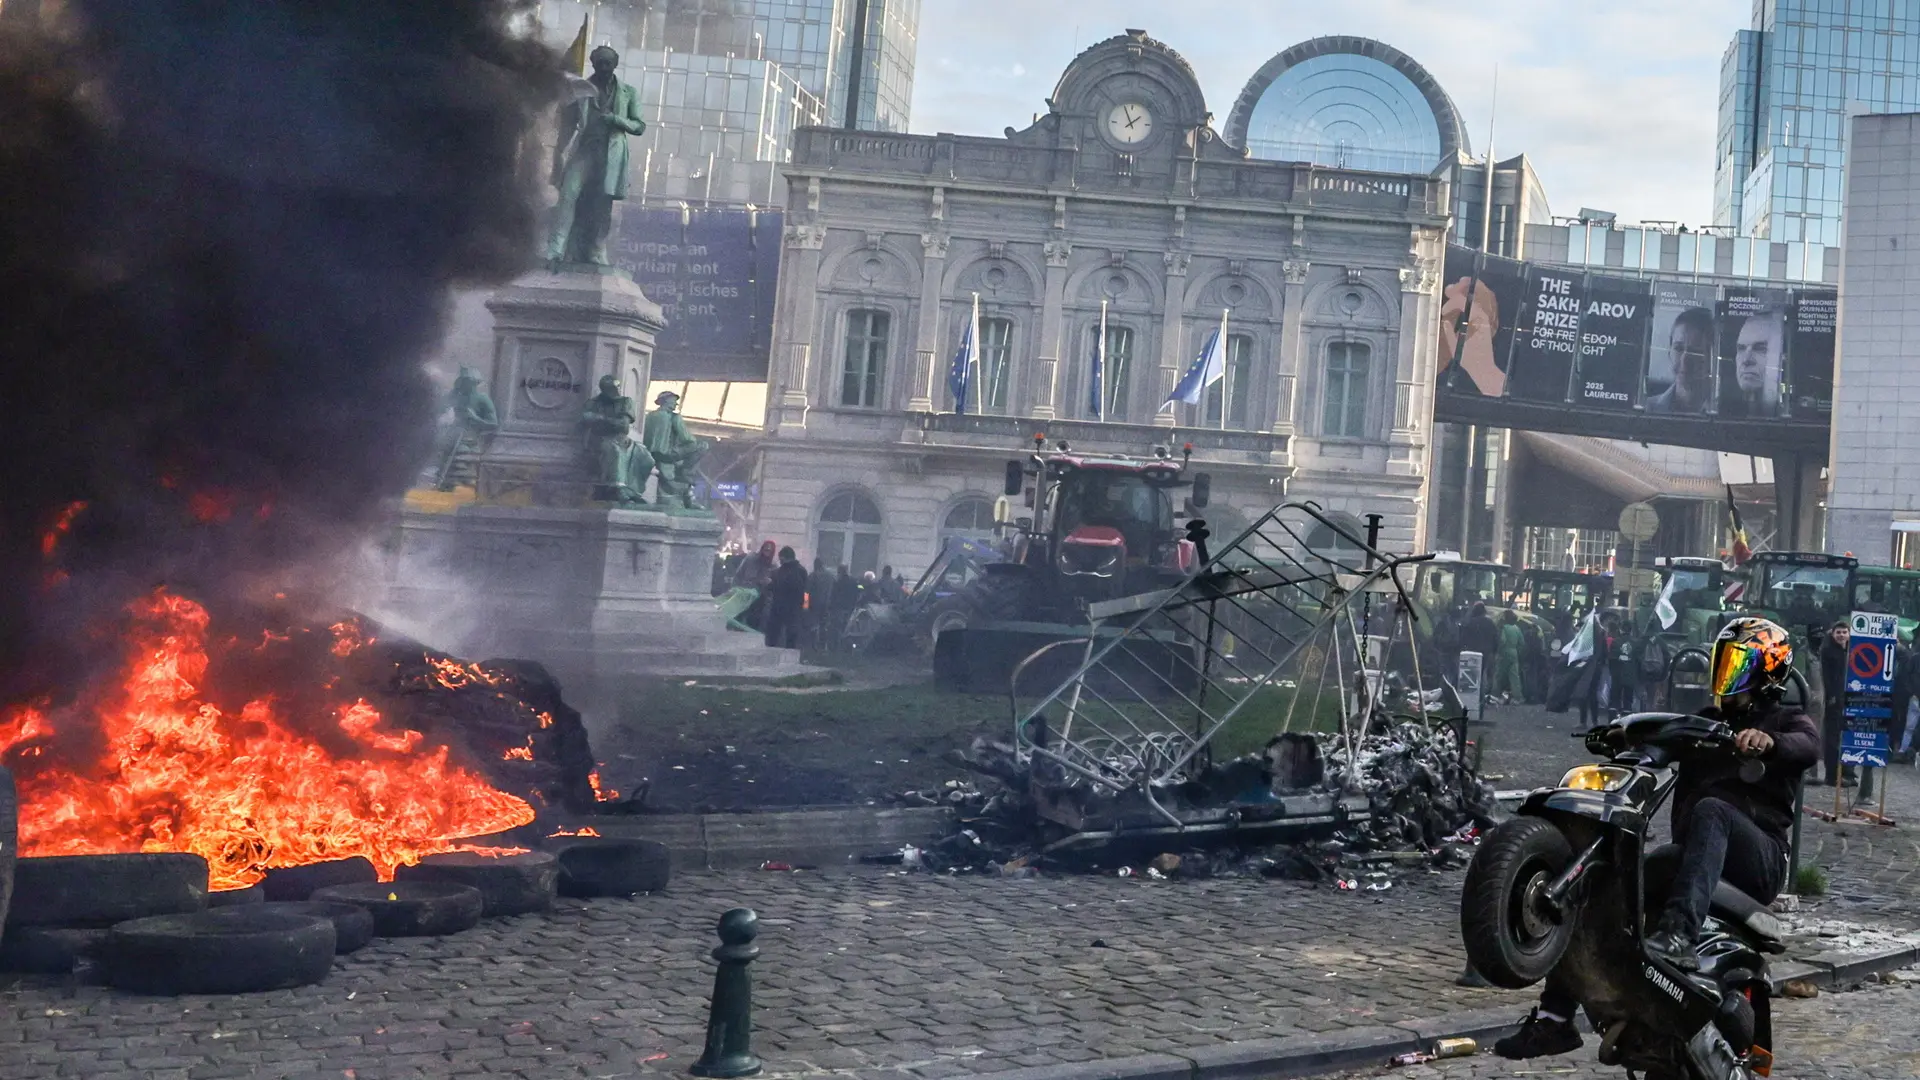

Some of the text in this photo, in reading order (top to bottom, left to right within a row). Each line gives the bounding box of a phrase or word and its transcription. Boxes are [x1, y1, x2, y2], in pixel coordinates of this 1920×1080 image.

[616, 239, 708, 257] European
[1541, 277, 1571, 294] THE
[1535, 310, 1579, 329] PRIZE
[1533, 326, 1554, 338] FOR
[1531, 338, 1546, 348] OF
[1585, 382, 1604, 390] 2025
[1584, 390, 1629, 401] LAUREATES
[1854, 732, 1877, 740] IXELLES
[1652, 970, 1685, 1003] YAMAHA
